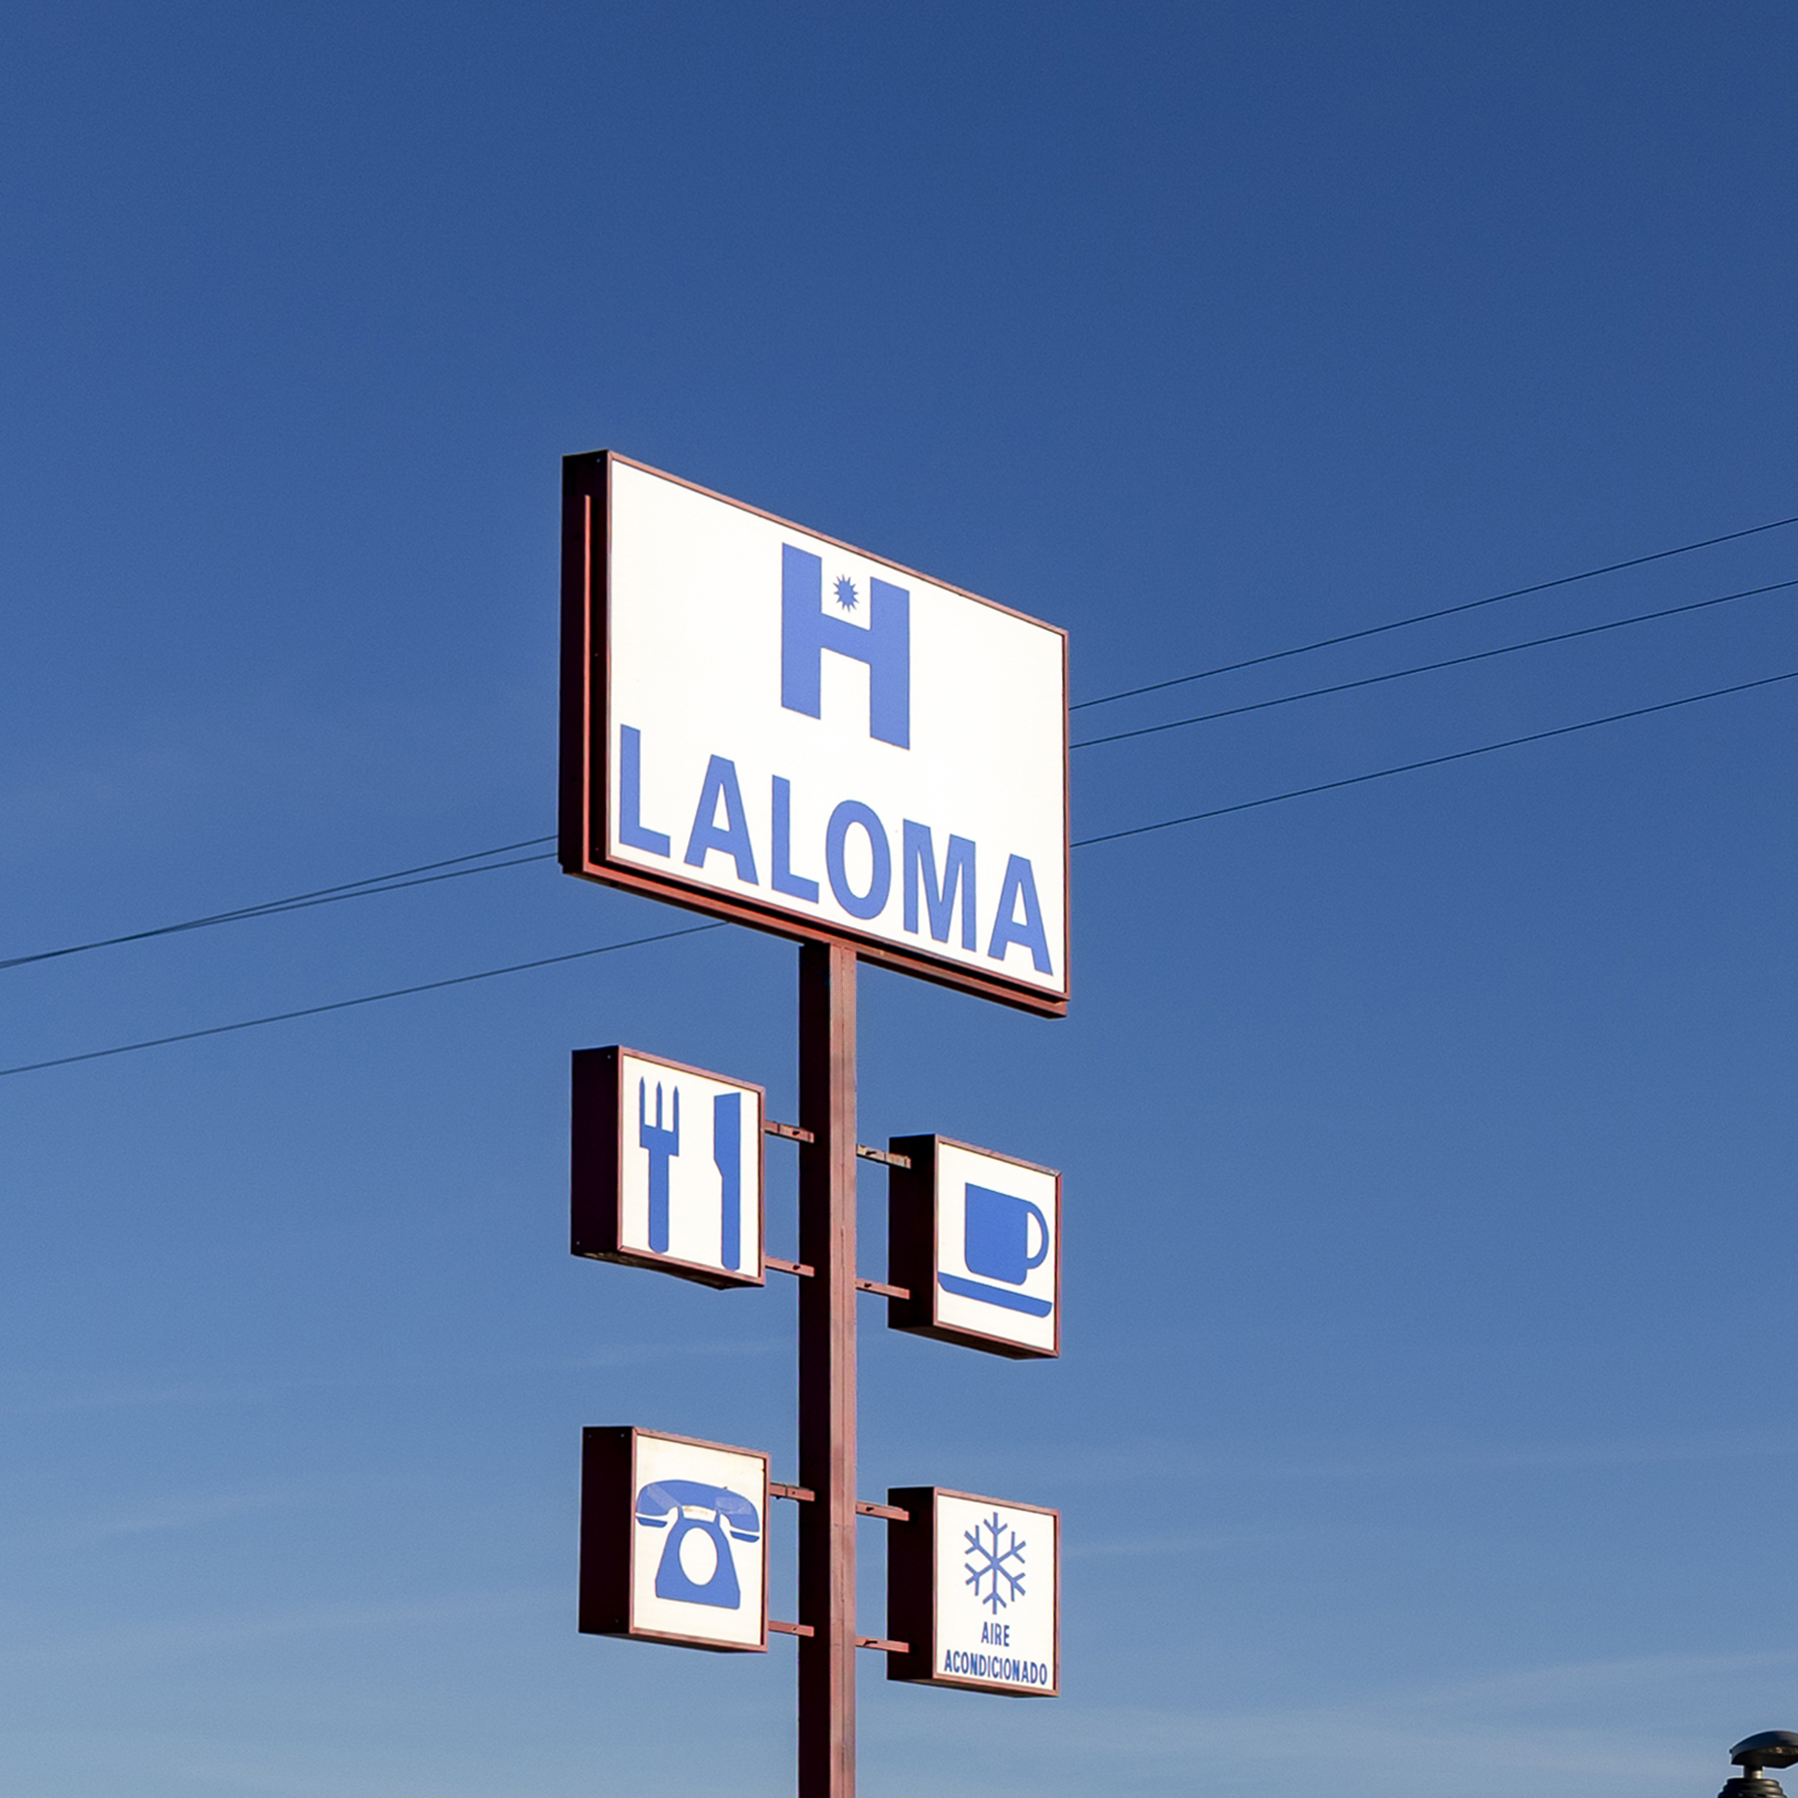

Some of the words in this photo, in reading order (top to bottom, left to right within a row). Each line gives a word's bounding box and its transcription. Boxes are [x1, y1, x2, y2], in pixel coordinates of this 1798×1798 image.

[780, 541, 911, 751] H
[981, 1621, 1010, 1647] AIRE
[944, 1649, 1048, 1686] ACONDICIONADO
